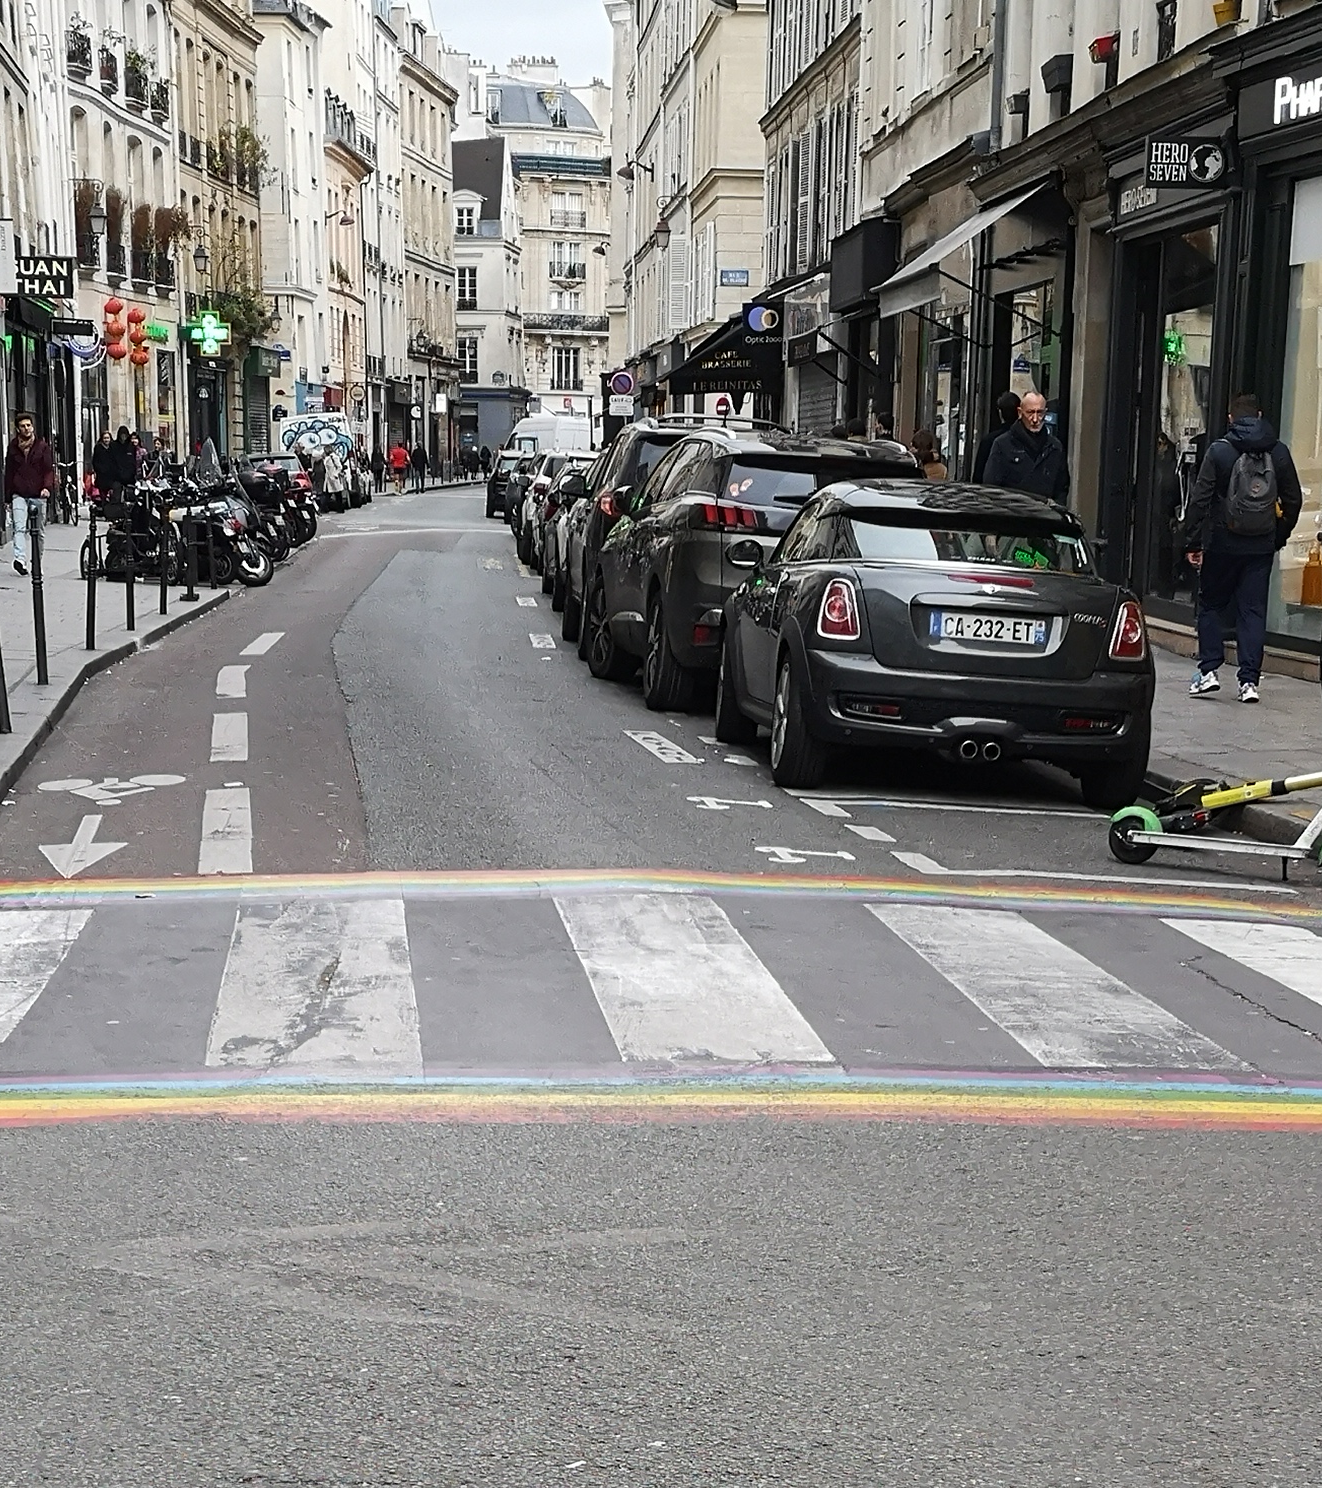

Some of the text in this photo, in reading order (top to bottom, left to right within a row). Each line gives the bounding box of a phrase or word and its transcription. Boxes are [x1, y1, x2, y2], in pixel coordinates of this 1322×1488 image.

[1151, 142, 1189, 163] HERO
[1149, 164, 1187, 181] SEVEN
[15, 279, 65, 295] THAI
[744, 335, 783, 345] Optic 2000
[701, 359, 752, 370] BRASSERIE
[943, 617, 1034, 643] CA-232-ET
[1034, 632, 1045, 642] 75
